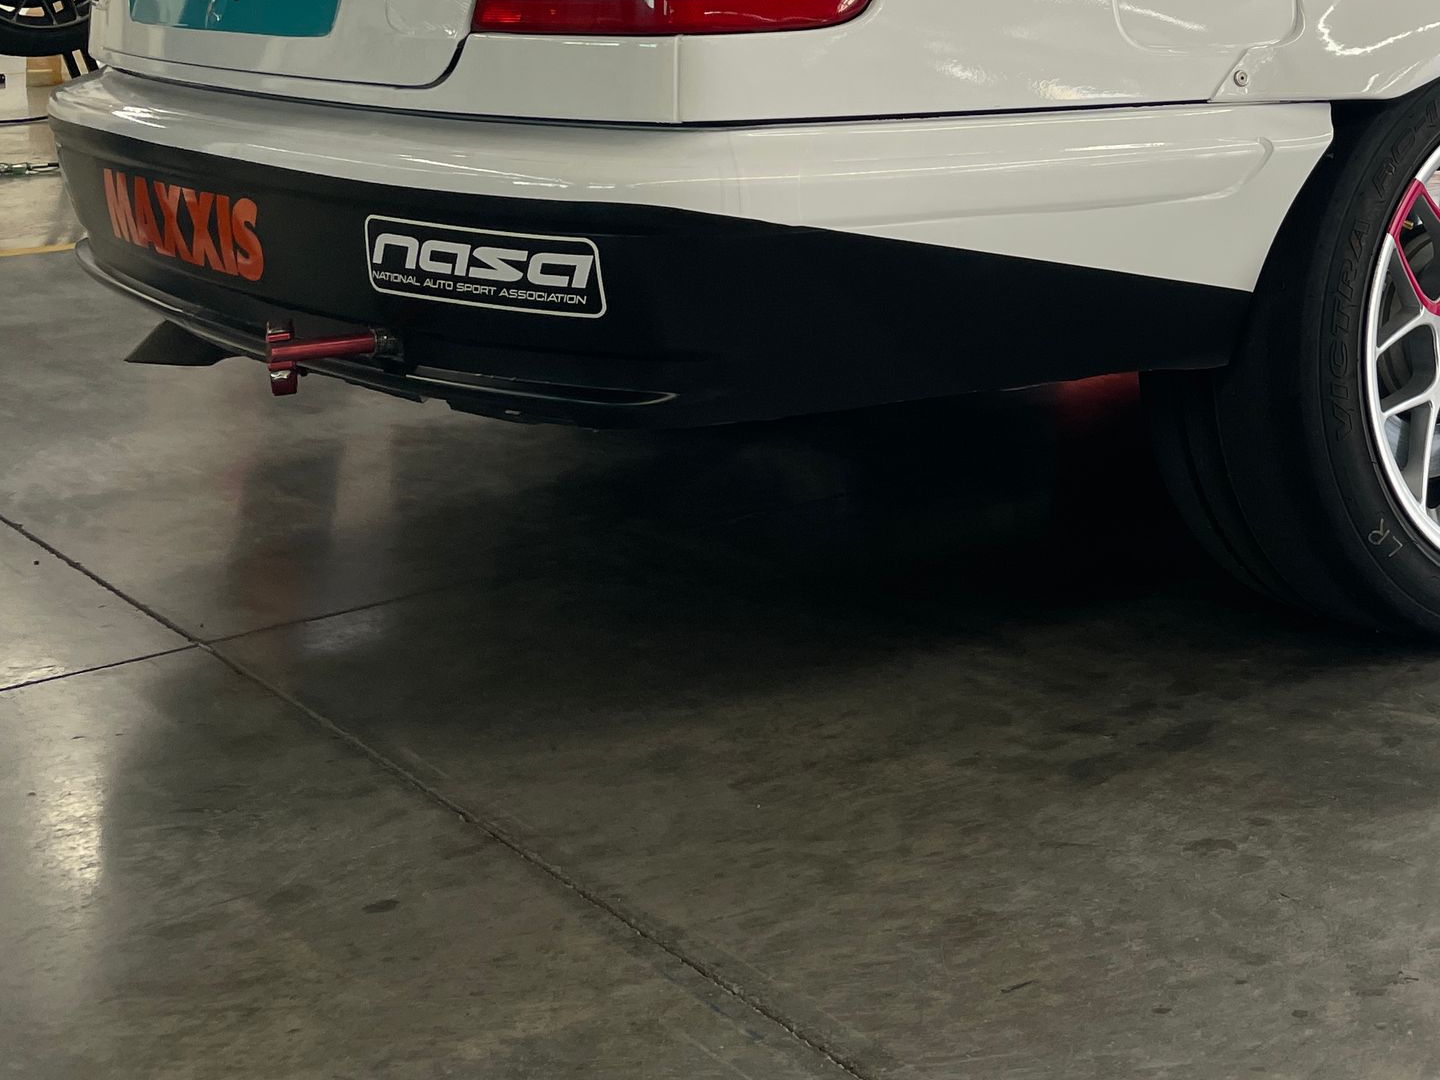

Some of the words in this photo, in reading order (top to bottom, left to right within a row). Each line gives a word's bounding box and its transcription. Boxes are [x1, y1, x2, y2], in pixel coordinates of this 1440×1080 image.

[103, 168, 265, 282] MAXXIS
[373, 233, 594, 289] nasa
[372, 271, 421, 286] NATIONAL
[423, 279, 454, 291] AUTO
[456, 283, 497, 297] SPORT
[498, 288, 588, 305] ASSOCIATION
[1368, 517, 1403, 558] LR
